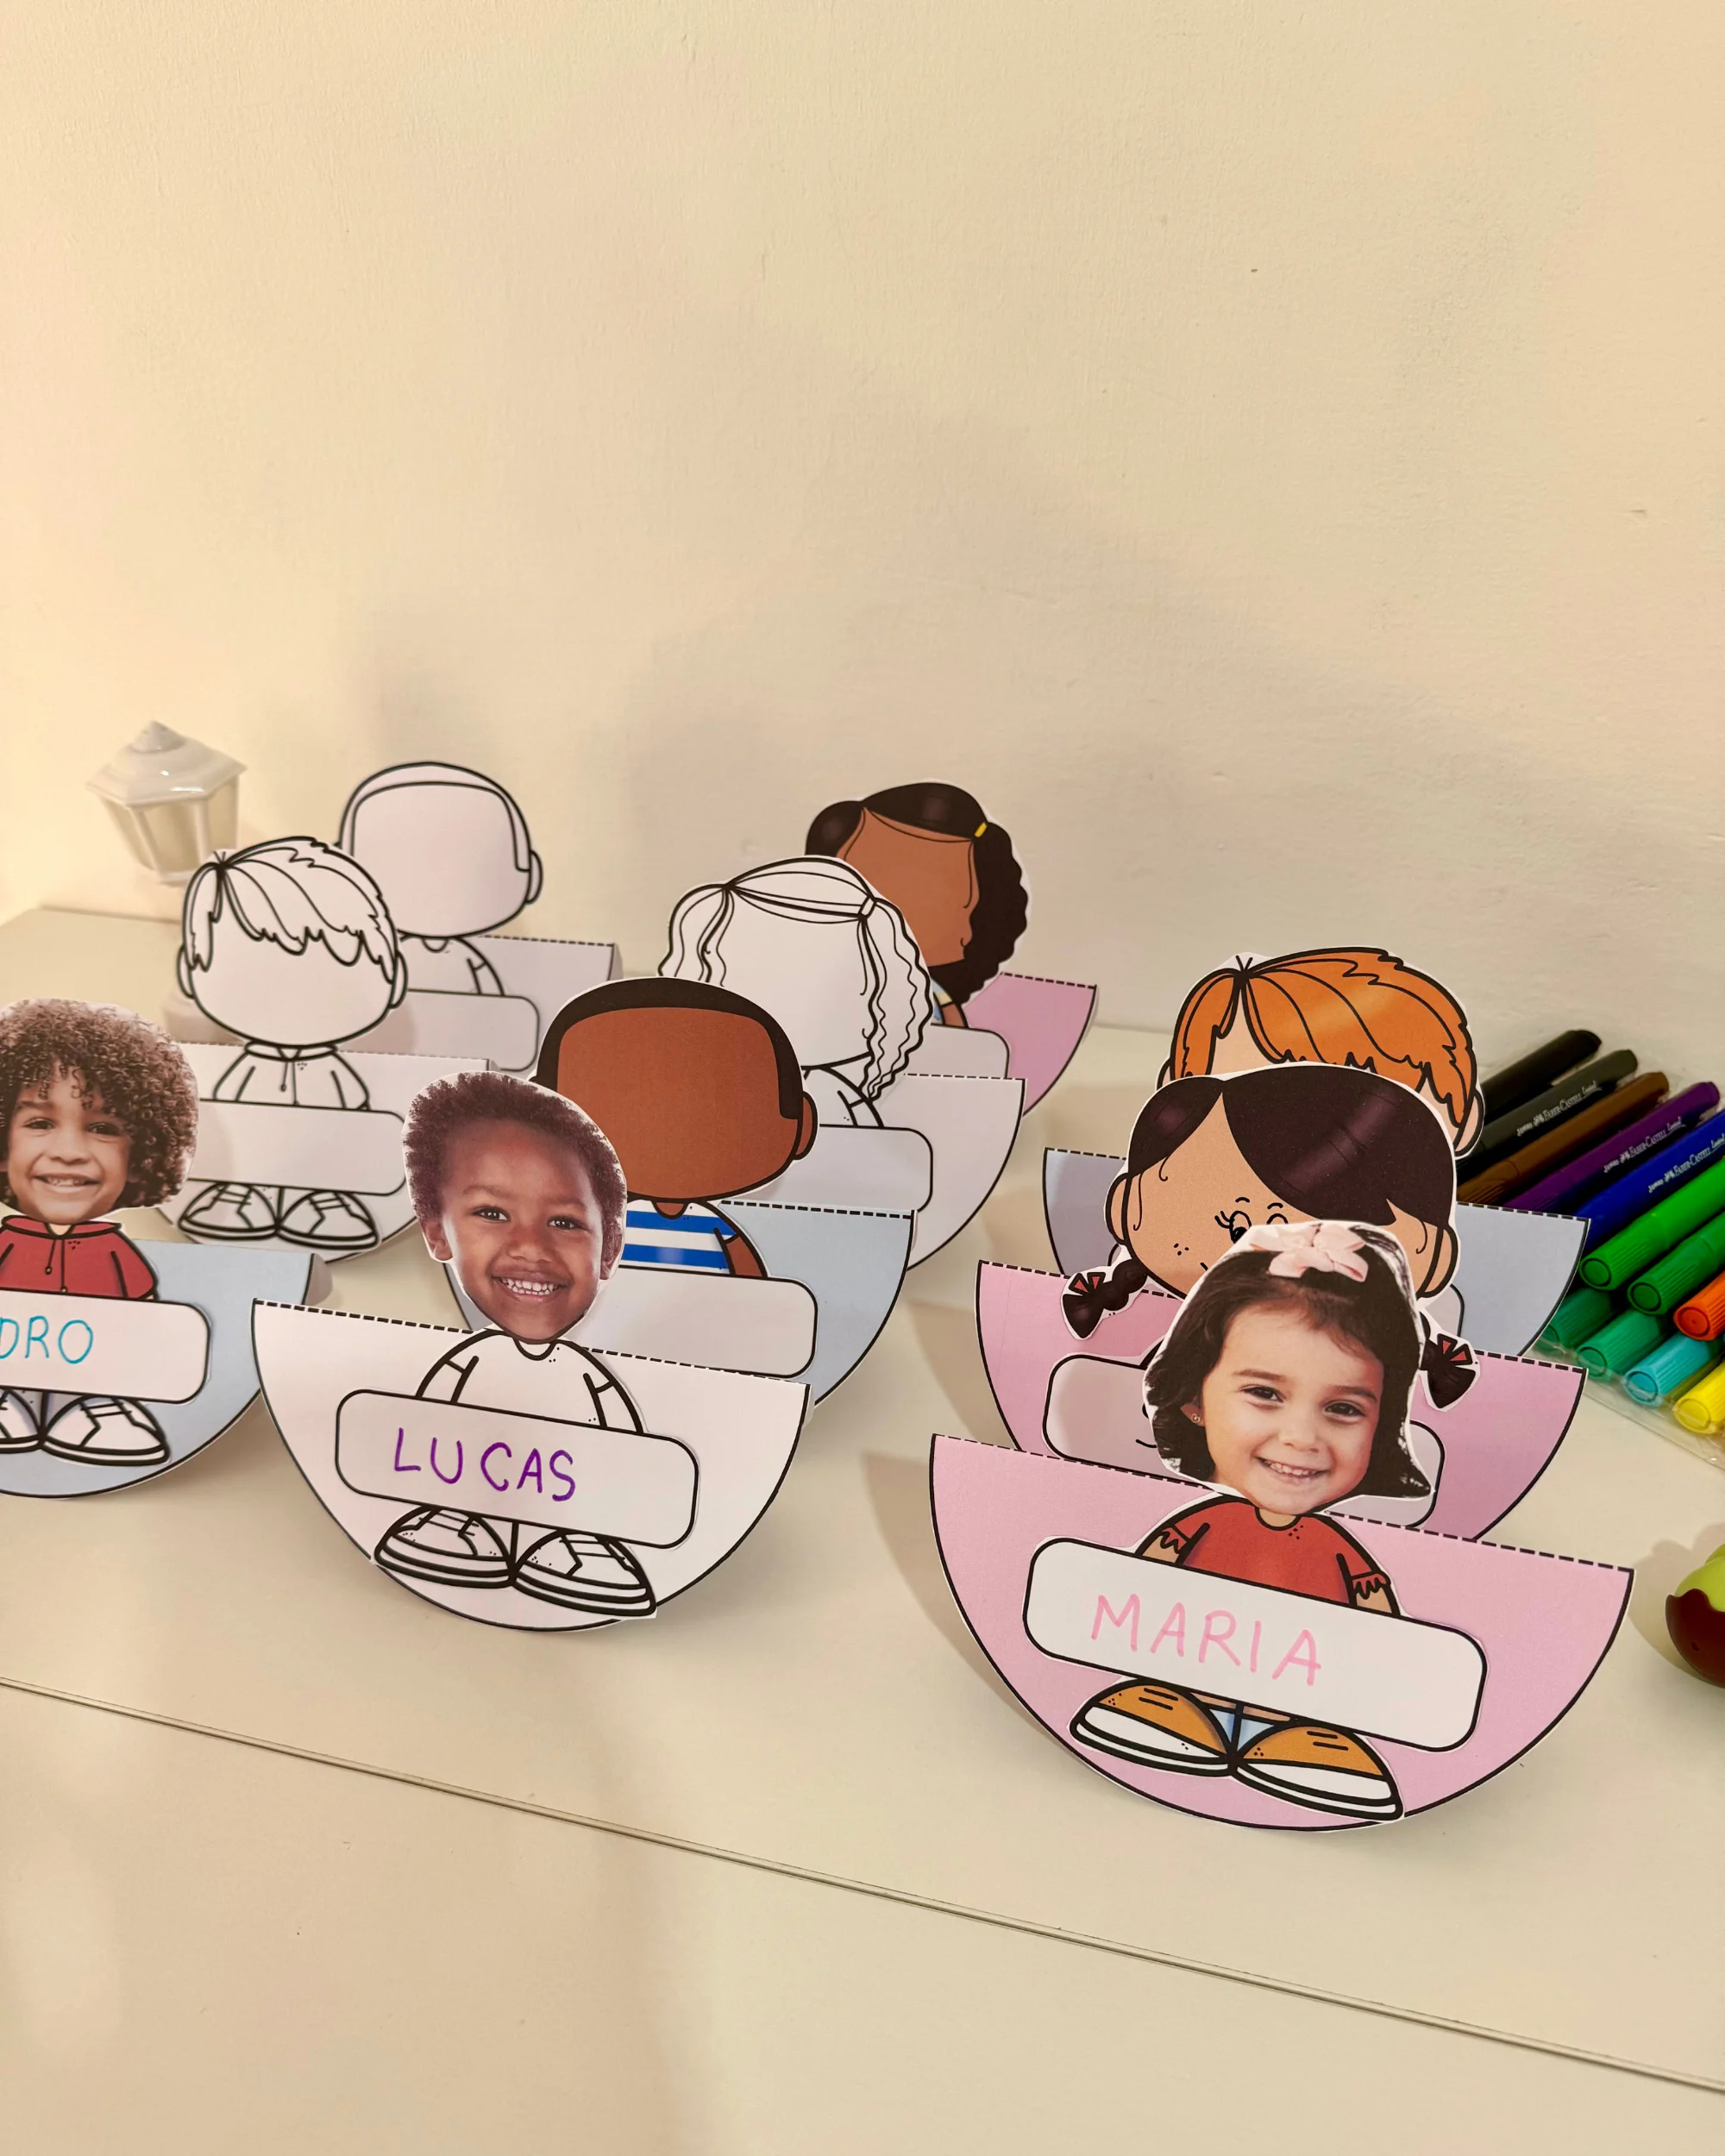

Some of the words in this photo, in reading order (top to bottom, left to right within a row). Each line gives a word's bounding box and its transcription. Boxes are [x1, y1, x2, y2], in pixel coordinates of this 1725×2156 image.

[0, 1316, 93, 1364] DRO
[394, 1428, 575, 1501] LUCAS
[1091, 1593, 1321, 1686] MARIA
